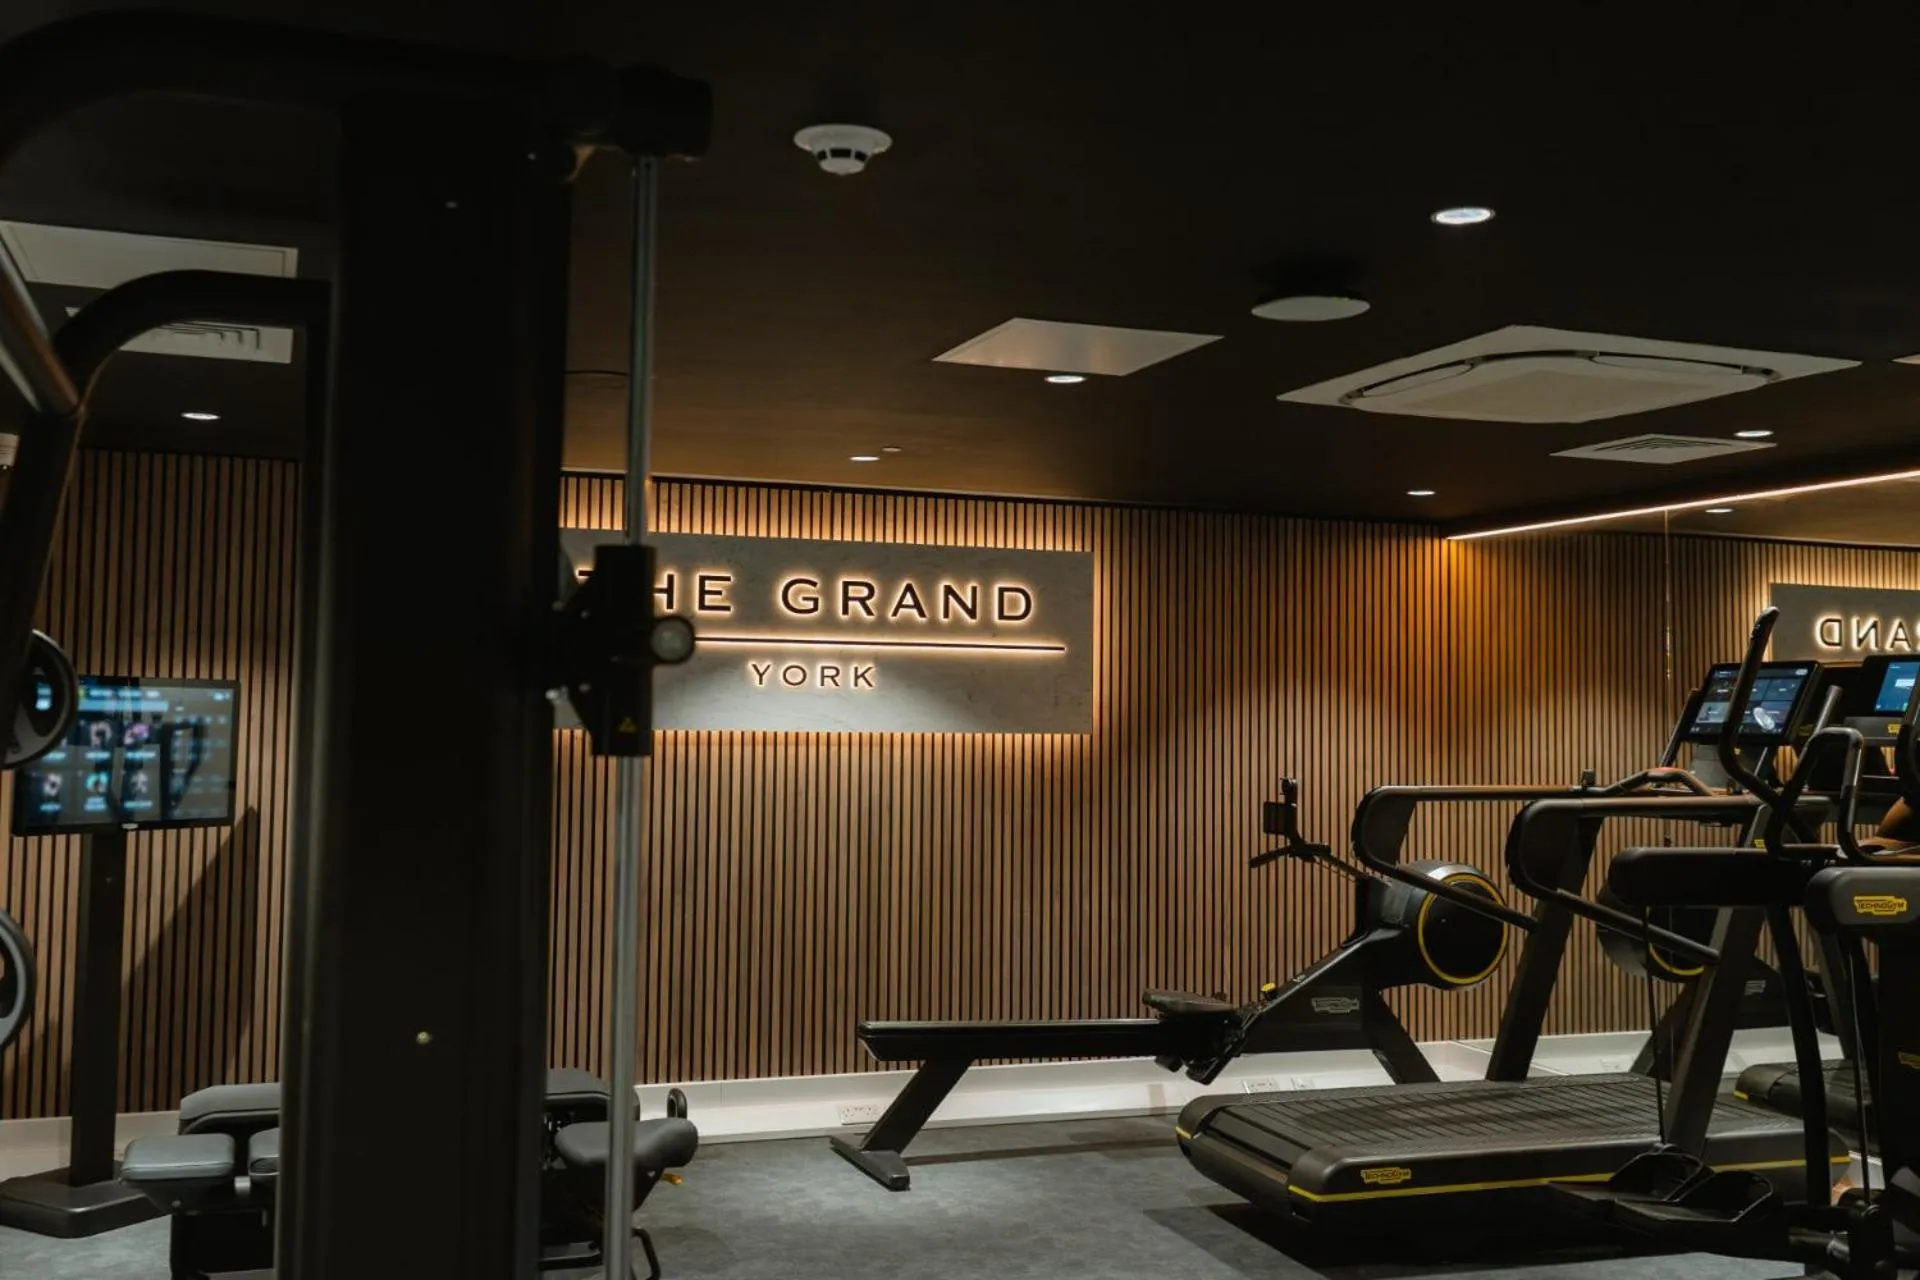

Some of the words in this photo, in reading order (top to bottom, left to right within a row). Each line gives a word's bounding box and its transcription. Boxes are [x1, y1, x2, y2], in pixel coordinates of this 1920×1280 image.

[577, 569, 732, 612] HE
[781, 577, 1032, 621] GRAND
[751, 663, 875, 688] YORK
